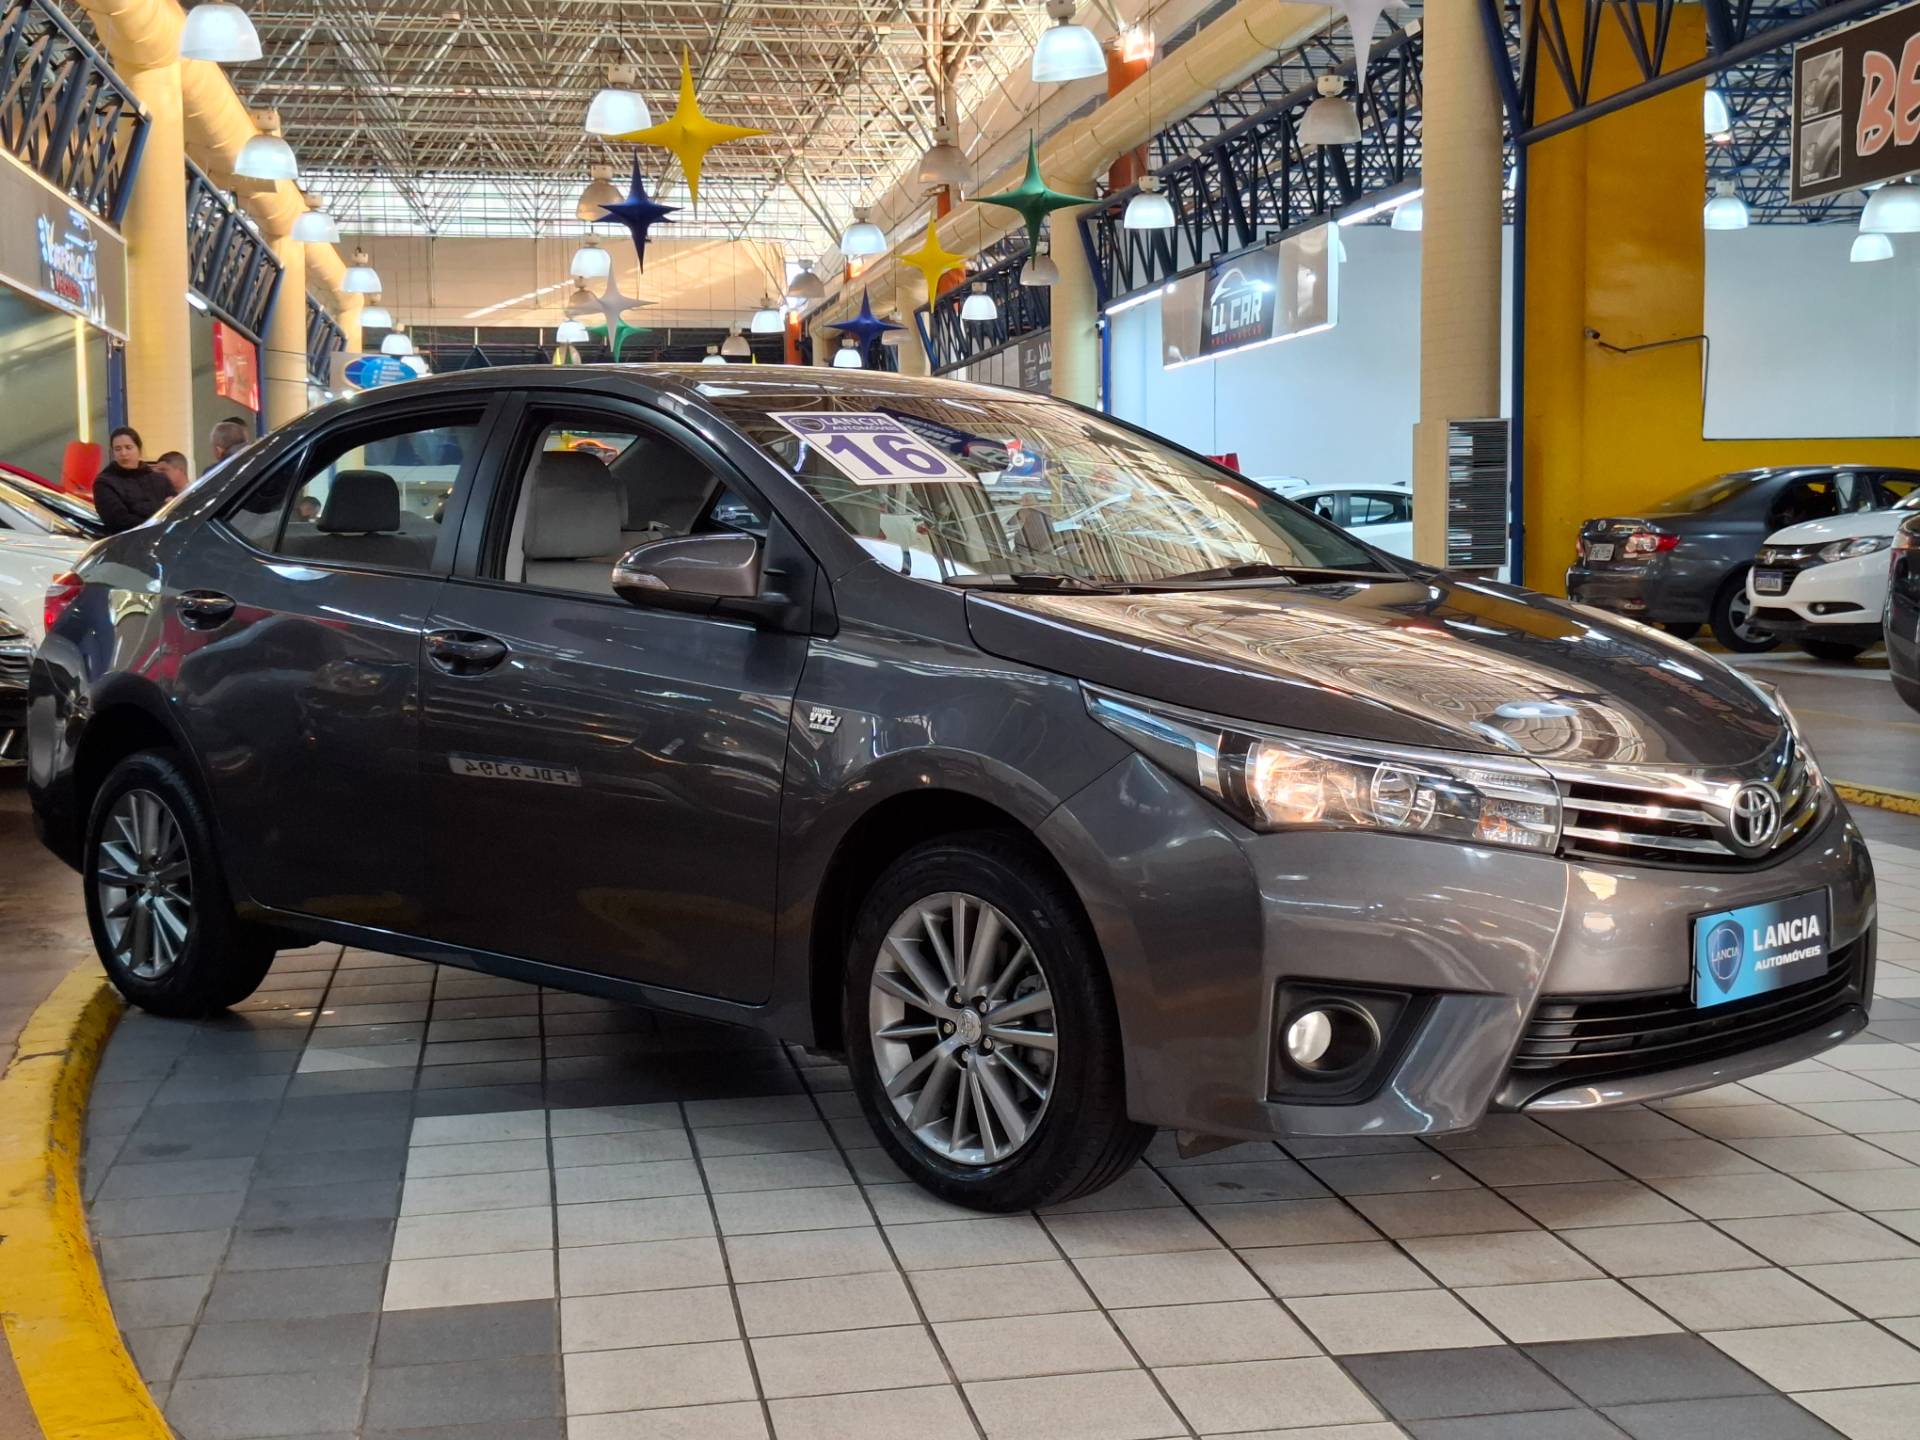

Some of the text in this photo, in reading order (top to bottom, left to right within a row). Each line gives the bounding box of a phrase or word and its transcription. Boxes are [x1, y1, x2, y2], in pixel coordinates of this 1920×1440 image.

[1211, 303, 1227, 335] LL
[1229, 291, 1263, 330] CAR
[820, 417, 894, 426] LANCIA
[826, 434, 948, 475] 16
[1752, 914, 1820, 952] LANCIA
[1711, 946, 1739, 963] LANCIA
[1754, 944, 1821, 971] AUTOMÓVEIS
